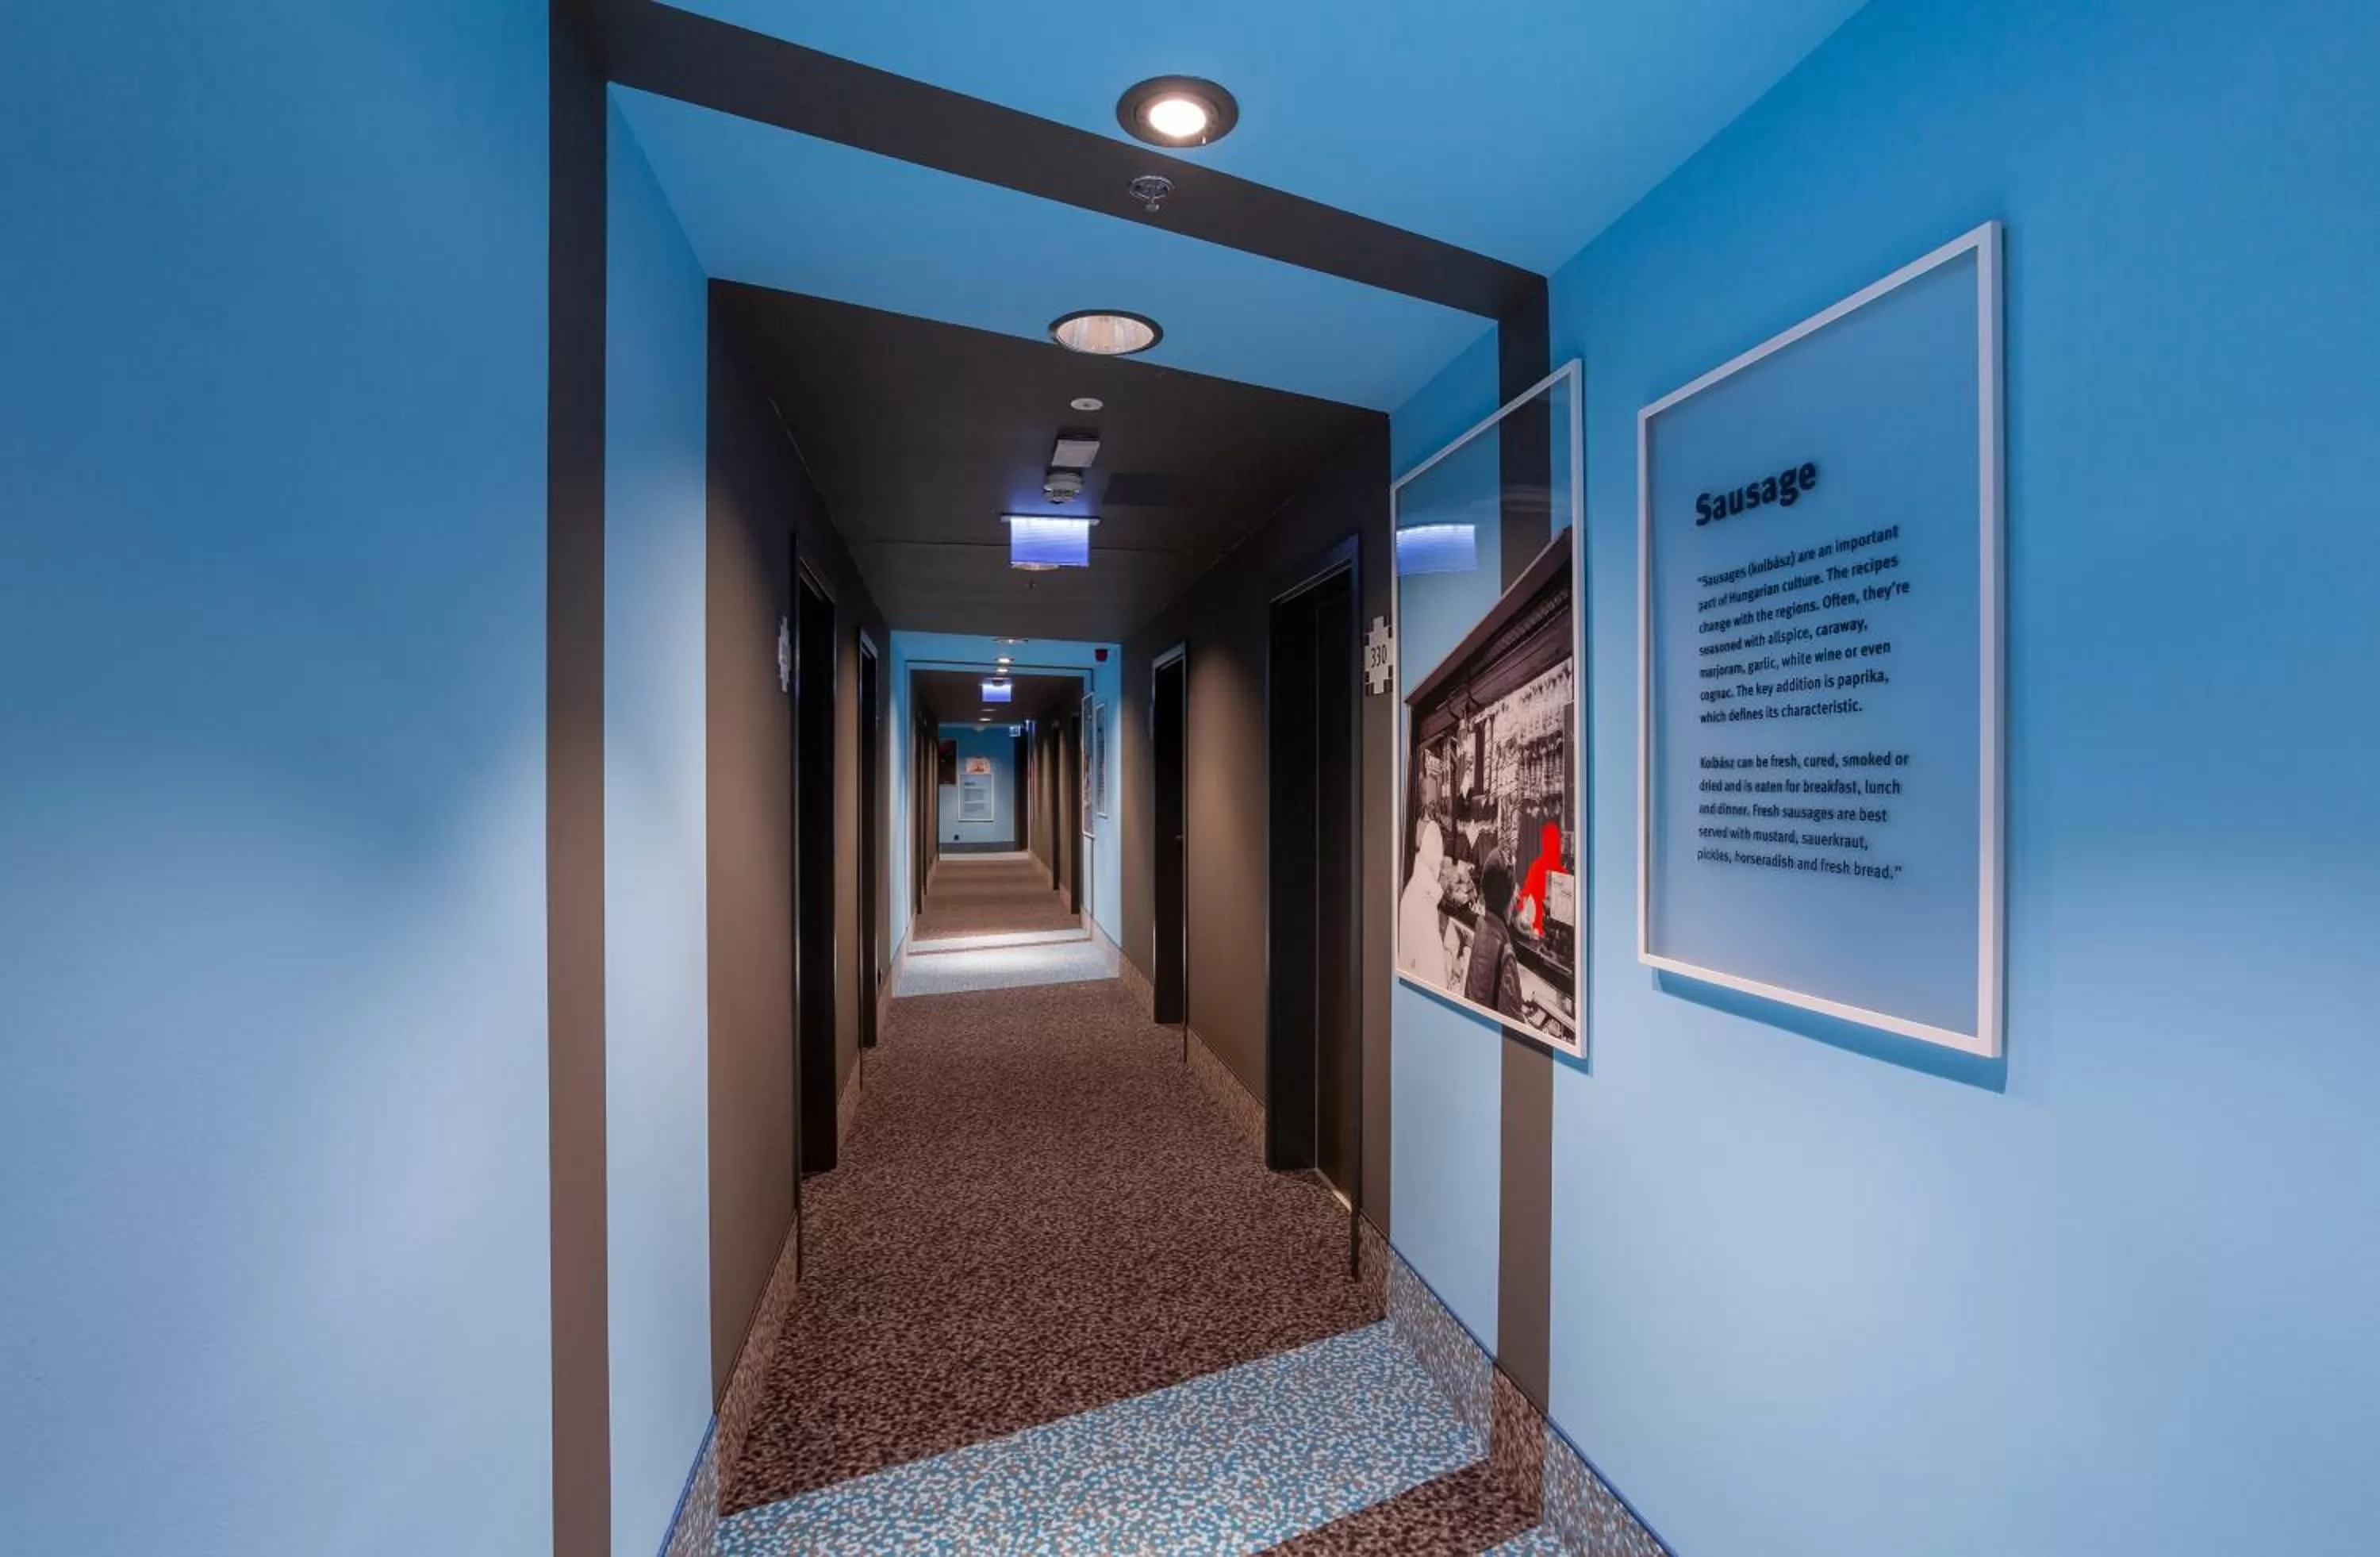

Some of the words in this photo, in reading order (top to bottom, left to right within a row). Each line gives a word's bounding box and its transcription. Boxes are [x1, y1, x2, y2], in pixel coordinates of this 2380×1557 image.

[1695, 461, 1817, 527] Sausage
[1797, 548, 1815, 563] are
[1817, 544, 1832, 558] an
[1834, 525, 1898, 553] important
[1698, 596, 1717, 613] part
[1717, 593, 1727, 606] of
[1728, 582, 1779, 603] Hungarian
[1781, 574, 1824, 592] culture.
[1825, 564, 1848, 582] The
[1850, 555, 1898, 577] recipes
[1698, 618, 1732, 634] change
[1732, 610, 1754, 626] with
[1755, 607, 1773, 622] the
[1774, 600, 1820, 620] regions.
[1821, 592, 1860, 609] Often,
[1698, 636, 1742, 656] seasoned
[1743, 633, 1765, 648] with
[1767, 626, 1813, 645] allspice,
[1371, 644, 1388, 668] 330
[1747, 655, 1779, 675] garlic,
[1780, 651, 1812, 667] white
[1814, 647, 1842, 663] wine
[1844, 646, 1858, 659] or
[1860, 641, 1891, 657] even
[1735, 683, 1754, 698] The
[1755, 681, 1773, 698] key
[1775, 675, 1821, 694] addition
[1823, 673, 1835, 688] is
[1837, 667, 1889, 690] paprika,
[1699, 709, 1726, 724] which
[1727, 706, 1764, 722] defines
[1764, 705, 1779, 719] its
[1780, 698, 1863, 717] characteristic.
[1736, 757, 1754, 768] can
[1755, 754, 1768, 769] be
[1769, 753, 1800, 769] fresh,
[1802, 752, 1839, 769] cured,
[1841, 750, 1891, 767] smoked
[1894, 754, 1909, 766] or
[1699, 778, 1722, 792] dried
[1723, 778, 1741, 792] and
[1742, 778, 1752, 793] is
[1753, 779, 1783, 794] eaten
[1784, 778, 1800, 794] for
[1802, 778, 1861, 797] breakfast,
[1864, 778, 1900, 794] lunch
[1698, 802, 1716, 815] and
[1752, 802, 1779, 817] Fresh
[1781, 806, 1834, 823] sausages
[1836, 809, 1856, 821] are
[1858, 805, 1887, 823] best
[1698, 825, 1728, 839] served
[1728, 826, 1752, 840] with
[1752, 828, 1798, 845] mustard,
[1800, 832, 1868, 851] sauerkraut,
[1696, 847, 1732, 863] pickles,
[1733, 850, 1795, 869] horseradish
[1796, 857, 1818, 871] and
[1819, 857, 1850, 875] fresh
